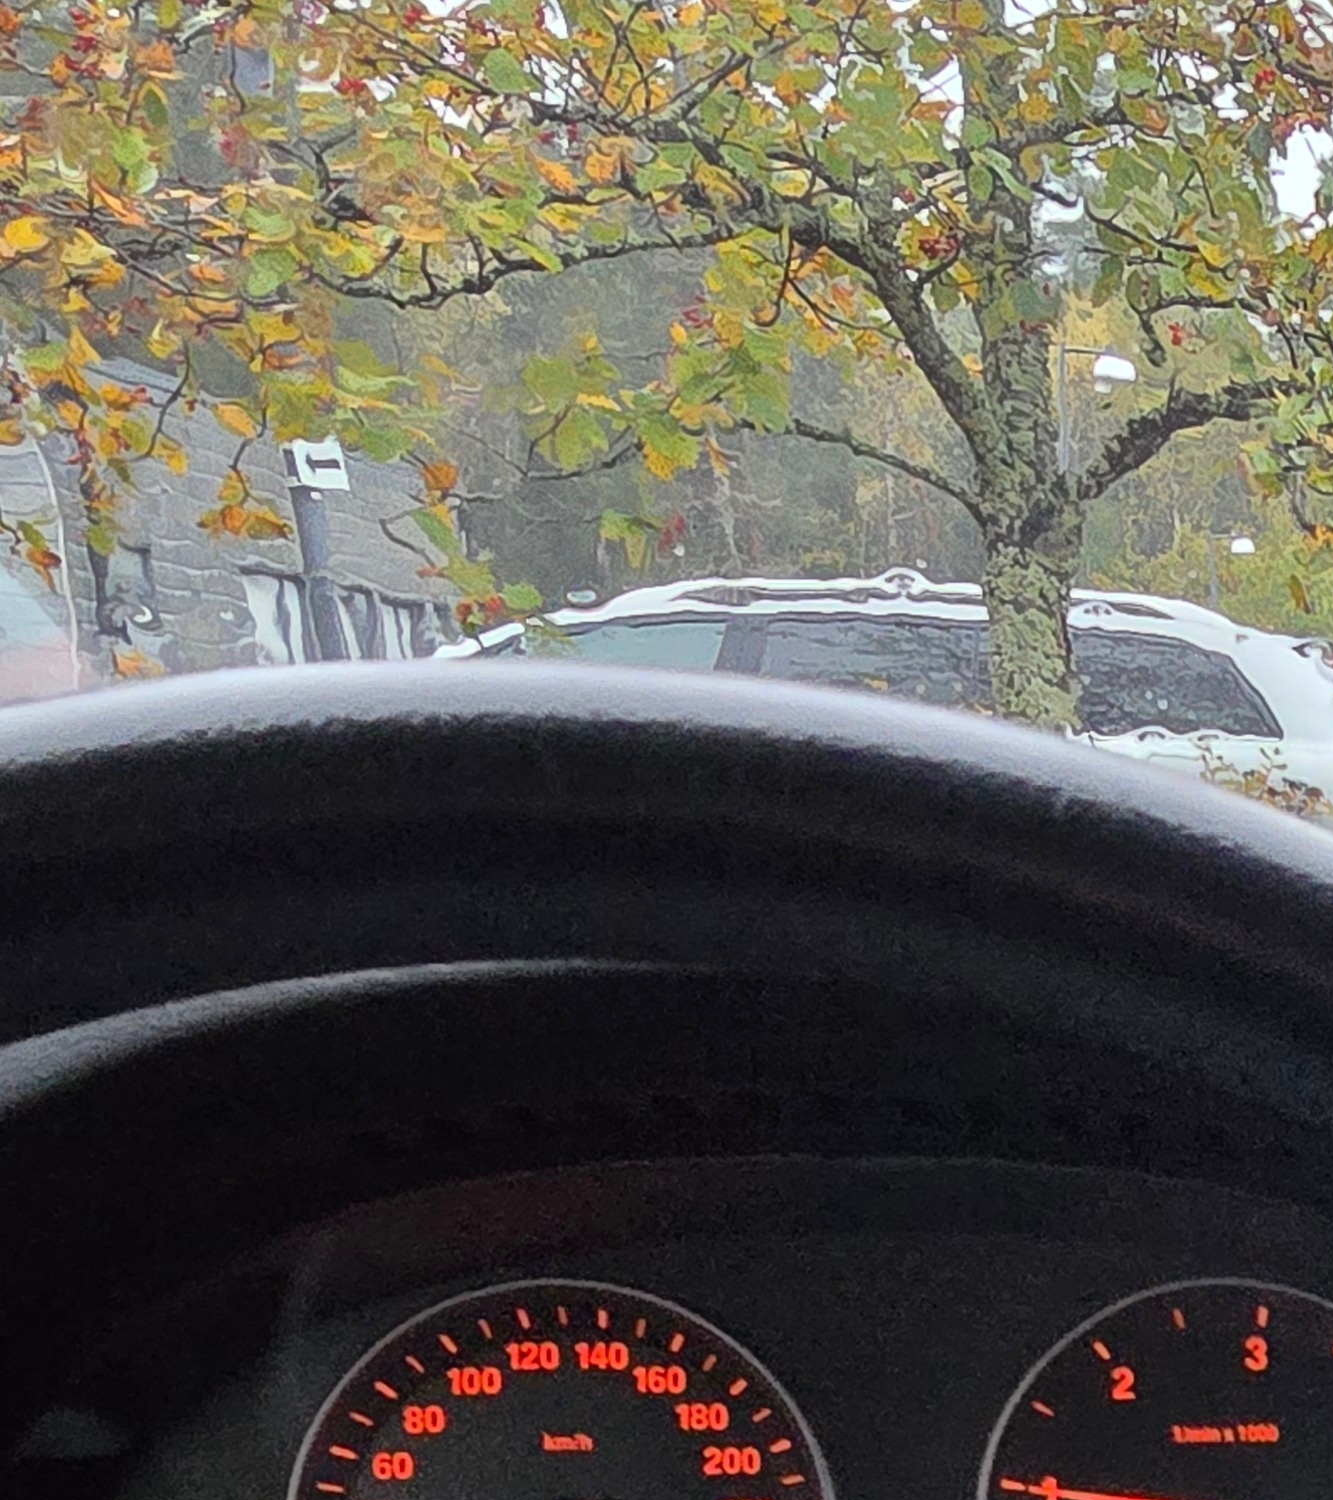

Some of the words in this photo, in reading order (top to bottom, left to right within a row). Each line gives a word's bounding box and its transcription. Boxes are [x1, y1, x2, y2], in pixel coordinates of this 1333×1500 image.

[506, 1342, 559, 1370] 120
[575, 1342, 629, 1370] 140
[1245, 1336, 1268, 1371] 3
[447, 1367, 502, 1395] 100
[633, 1366, 686, 1394] 160
[1112, 1367, 1135, 1400] 2
[403, 1405, 446, 1434] 80
[676, 1403, 729, 1430] 180
[543, 1433, 593, 1451] km/h
[1223, 1428, 1234, 1442] x
[372, 1452, 413, 1479] 60
[703, 1447, 760, 1475] 200
